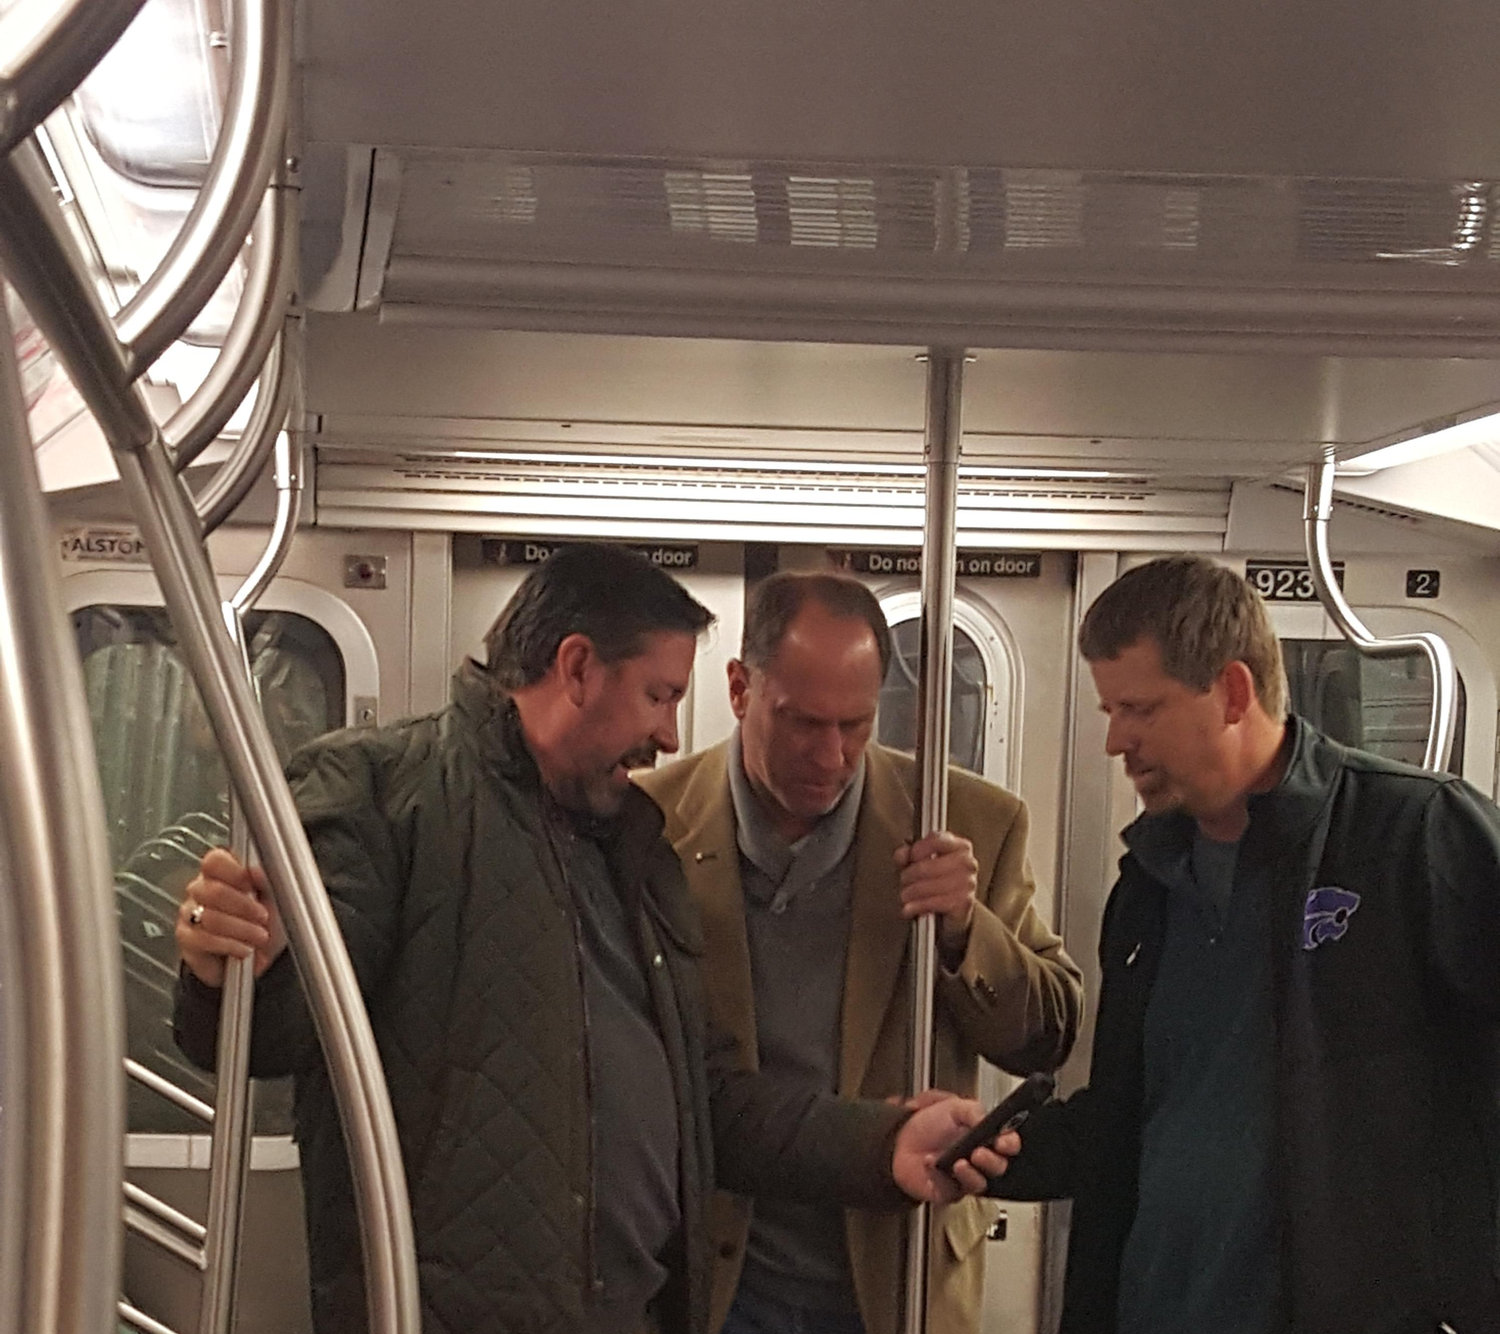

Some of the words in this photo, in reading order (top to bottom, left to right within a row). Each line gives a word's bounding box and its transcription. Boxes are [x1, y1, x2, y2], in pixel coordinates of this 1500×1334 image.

[525, 544, 550, 562] Do
[652, 548, 692, 566] door
[869, 554, 892, 571] Do
[969, 560, 990, 573] on
[994, 557, 1035, 574] door
[1256, 570, 1315, 598] 923
[1415, 574, 1431, 595] 2
